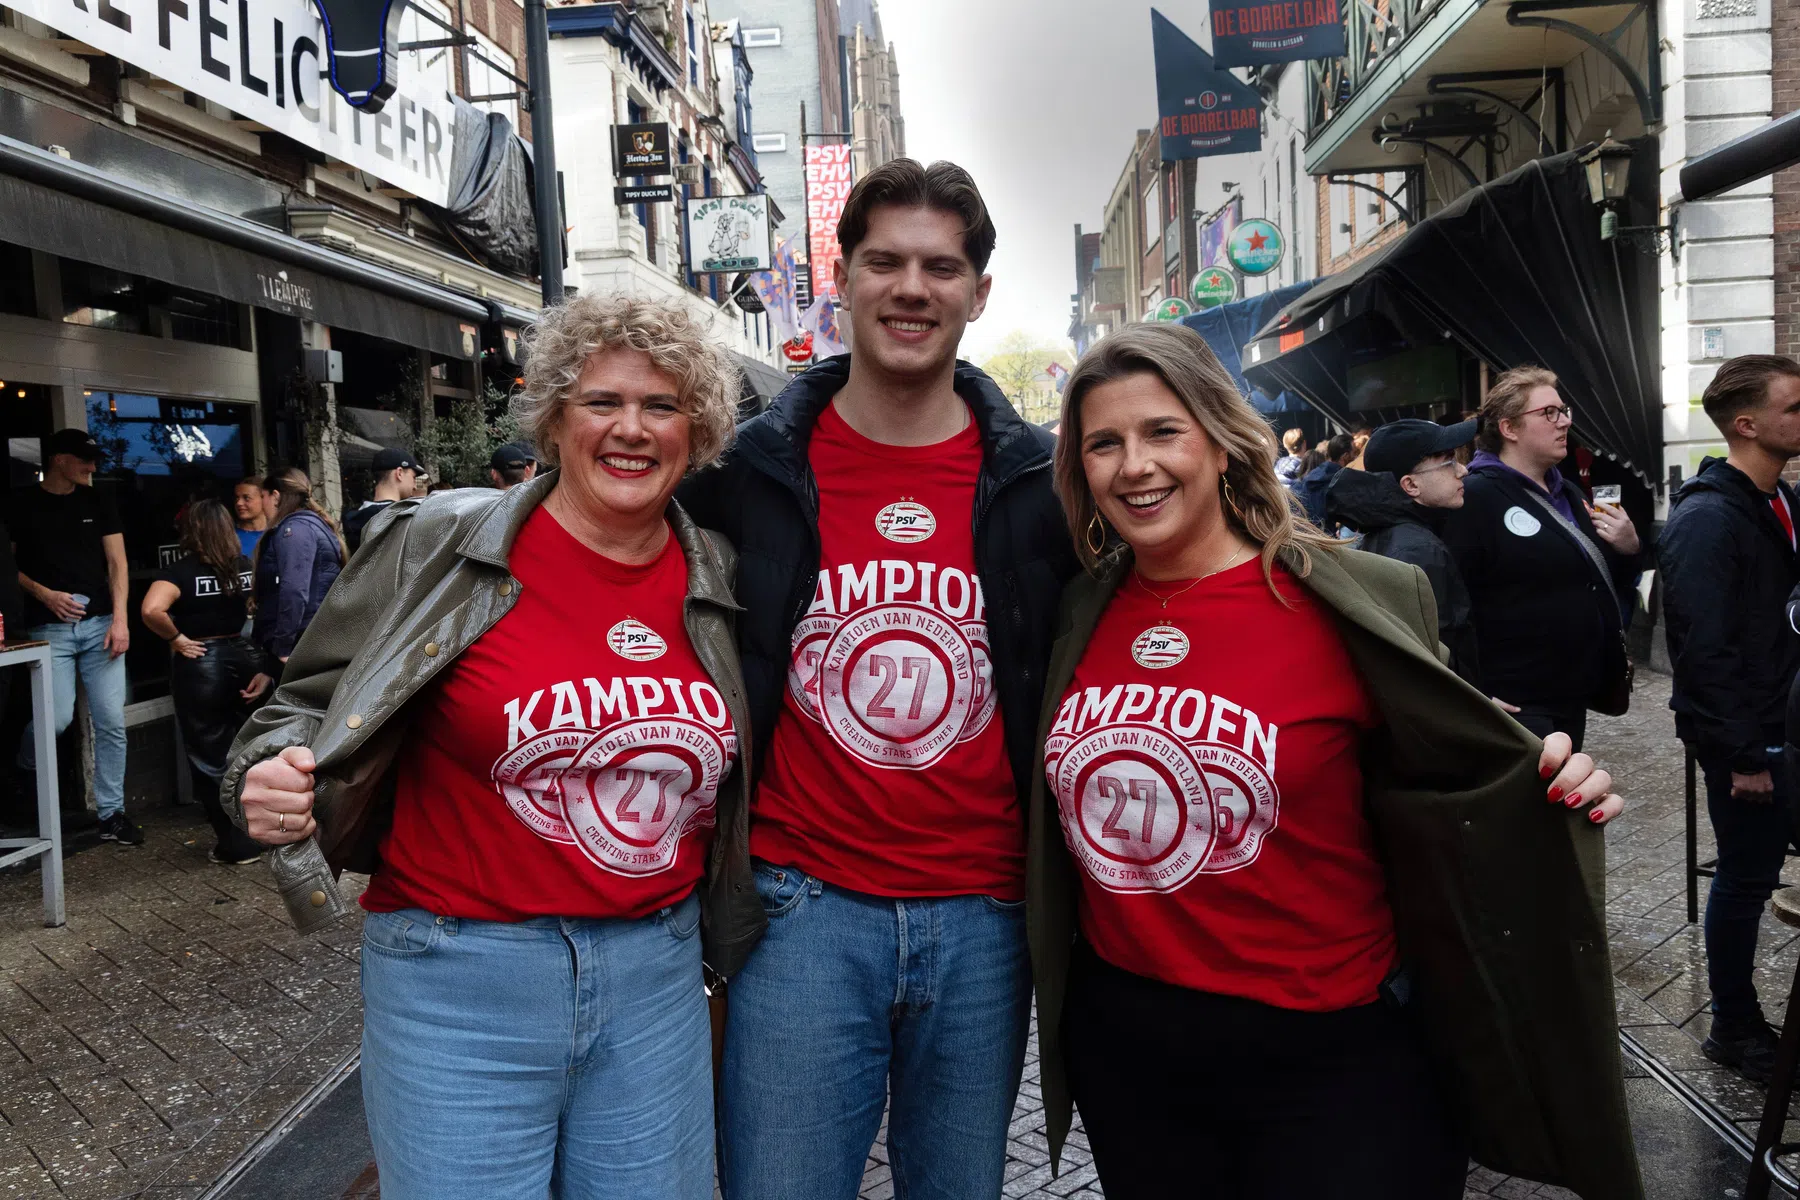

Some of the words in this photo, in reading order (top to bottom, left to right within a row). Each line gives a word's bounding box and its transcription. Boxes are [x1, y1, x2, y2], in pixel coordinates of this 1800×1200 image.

[1213, 9, 1237, 37] DE
[1238, 0, 1339, 35] BORRELBAR
[1162, 116, 1178, 136] DE
[1181, 108, 1258, 135] BORRELBAR
[626, 154, 649, 164] Hertog
[650, 154, 663, 162] Jan
[806, 144, 851, 164] PSV
[807, 164, 850, 181] EHV
[808, 182, 851, 200] PSV
[694, 199, 722, 220] TIPSY
[730, 199, 764, 220] DUCK
[810, 218, 840, 236] PS
[1241, 256, 1274, 265] SILVER
[269, 278, 313, 310] LEMPKE
[1198, 289, 1232, 298] Heineken
[896, 516, 917, 524] PSV
[628, 634, 648, 643] PSV
[812, 620, 830, 630] VAN
[828, 616, 880, 672] KAMPIOEN
[883, 612, 911, 624] VAN
[916, 615, 969, 680] NEDERLAND
[1149, 641, 1170, 649] PSV
[866, 654, 931, 720] 27
[504, 676, 734, 750] KAMPIO
[839, 717, 879, 754] CREATING
[882, 746, 912, 759] STARS
[913, 724, 954, 756] TOGETHER
[1050, 740, 1063, 749] VAN
[502, 740, 551, 780] KAMPIOEN
[554, 736, 579, 746] VAN
[639, 726, 670, 740] VAN
[676, 727, 719, 792] NEDERLAND
[1062, 736, 1108, 793] KAMPIOEN
[1112, 732, 1140, 744] VAN
[1143, 736, 1203, 806] NEDERLAND
[1195, 750, 1218, 760] VAN
[1222, 753, 1270, 805] NEDERLAND
[615, 769, 685, 823] 27
[1097, 775, 1157, 843] 27
[516, 800, 551, 828] CREATING
[586, 825, 630, 862] CREATING
[632, 854, 661, 864] STARS
[1228, 832, 1256, 860] TOGETHER
[1078, 840, 1115, 878] CREATING
[1119, 870, 1149, 880] STARS
